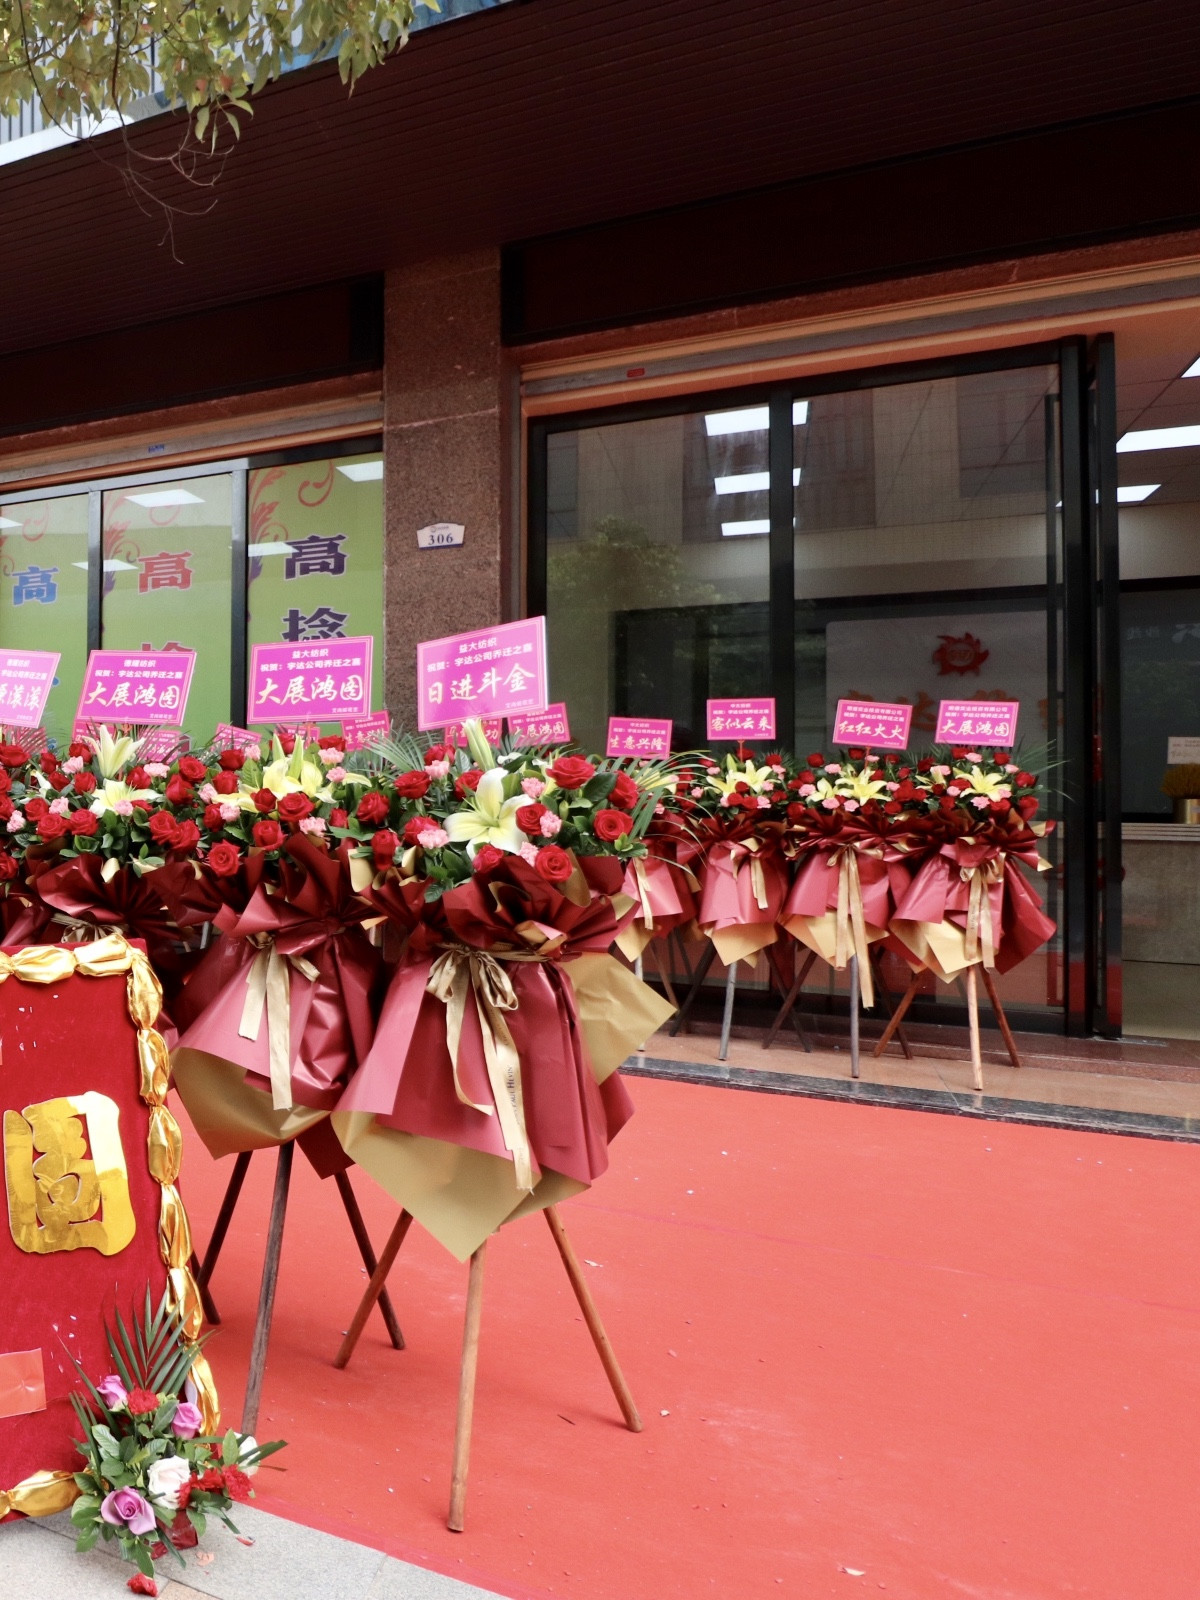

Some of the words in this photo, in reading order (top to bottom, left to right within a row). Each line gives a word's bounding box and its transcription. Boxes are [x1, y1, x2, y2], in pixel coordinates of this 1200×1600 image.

[428, 533, 454, 546] 306
[256, 674, 363, 705] 大展鸿图
[428, 663, 535, 704] 日进斗金
[84, 682, 180, 709] 大展鸿图
[711, 716, 772, 731] 客似云来
[839, 720, 905, 741] 红红火火
[940, 720, 1009, 736] 大展鸿图
[610, 735, 667, 750] 生意兴隆
